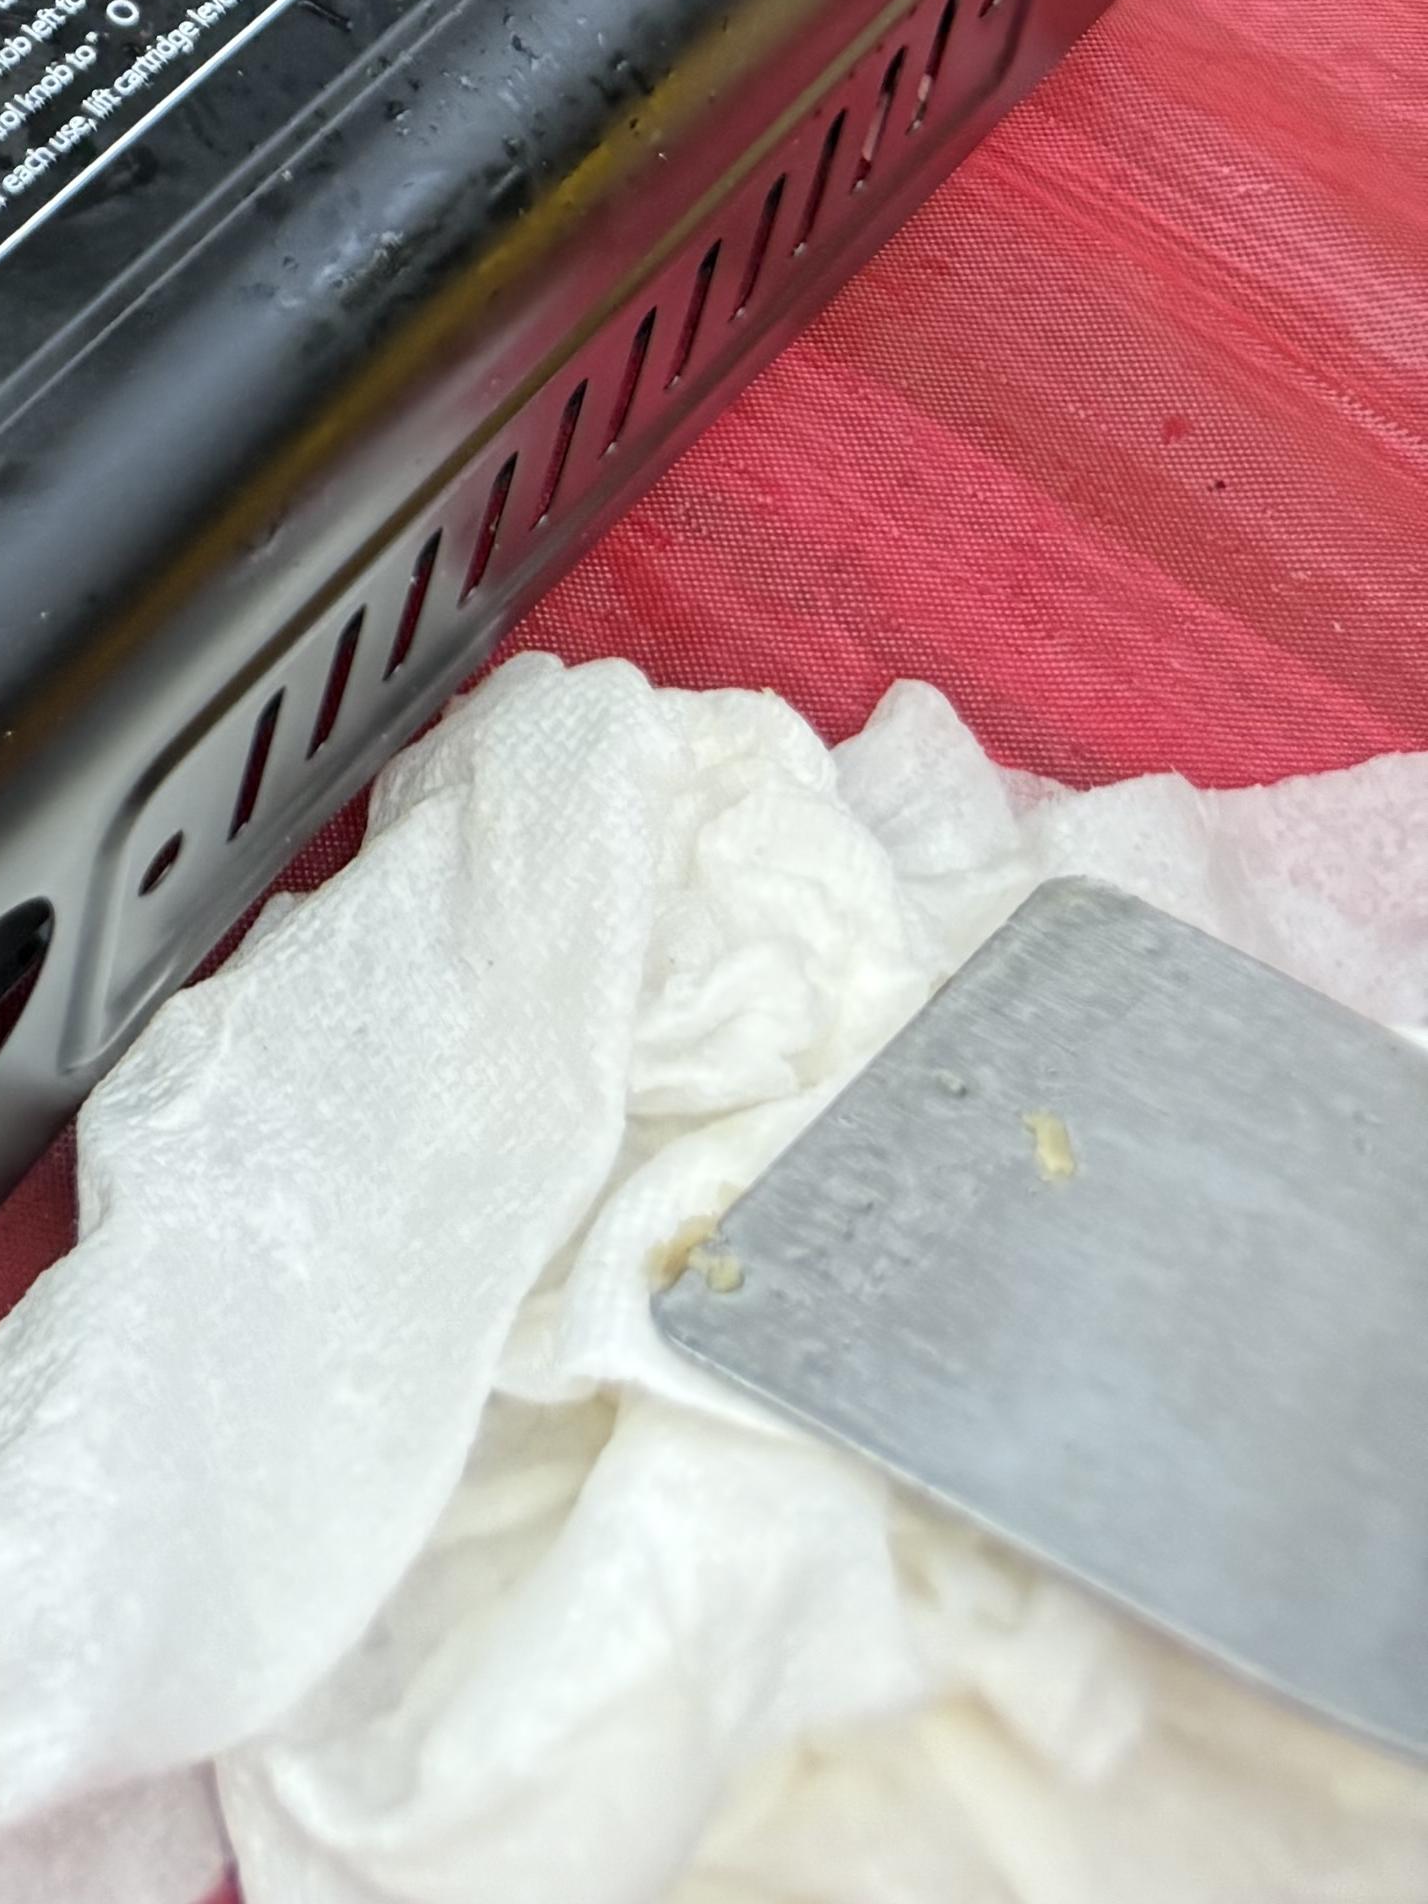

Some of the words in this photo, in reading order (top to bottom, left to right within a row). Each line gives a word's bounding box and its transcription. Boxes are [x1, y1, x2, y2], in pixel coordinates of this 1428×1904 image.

[20, 7, 67, 43] left
[1, 146, 57, 194] each
[48, 115, 97, 153] use,
[81, 88, 122, 119] lift
[113, 20, 200, 96] cartridge
[13, 61, 74, 113] knob
